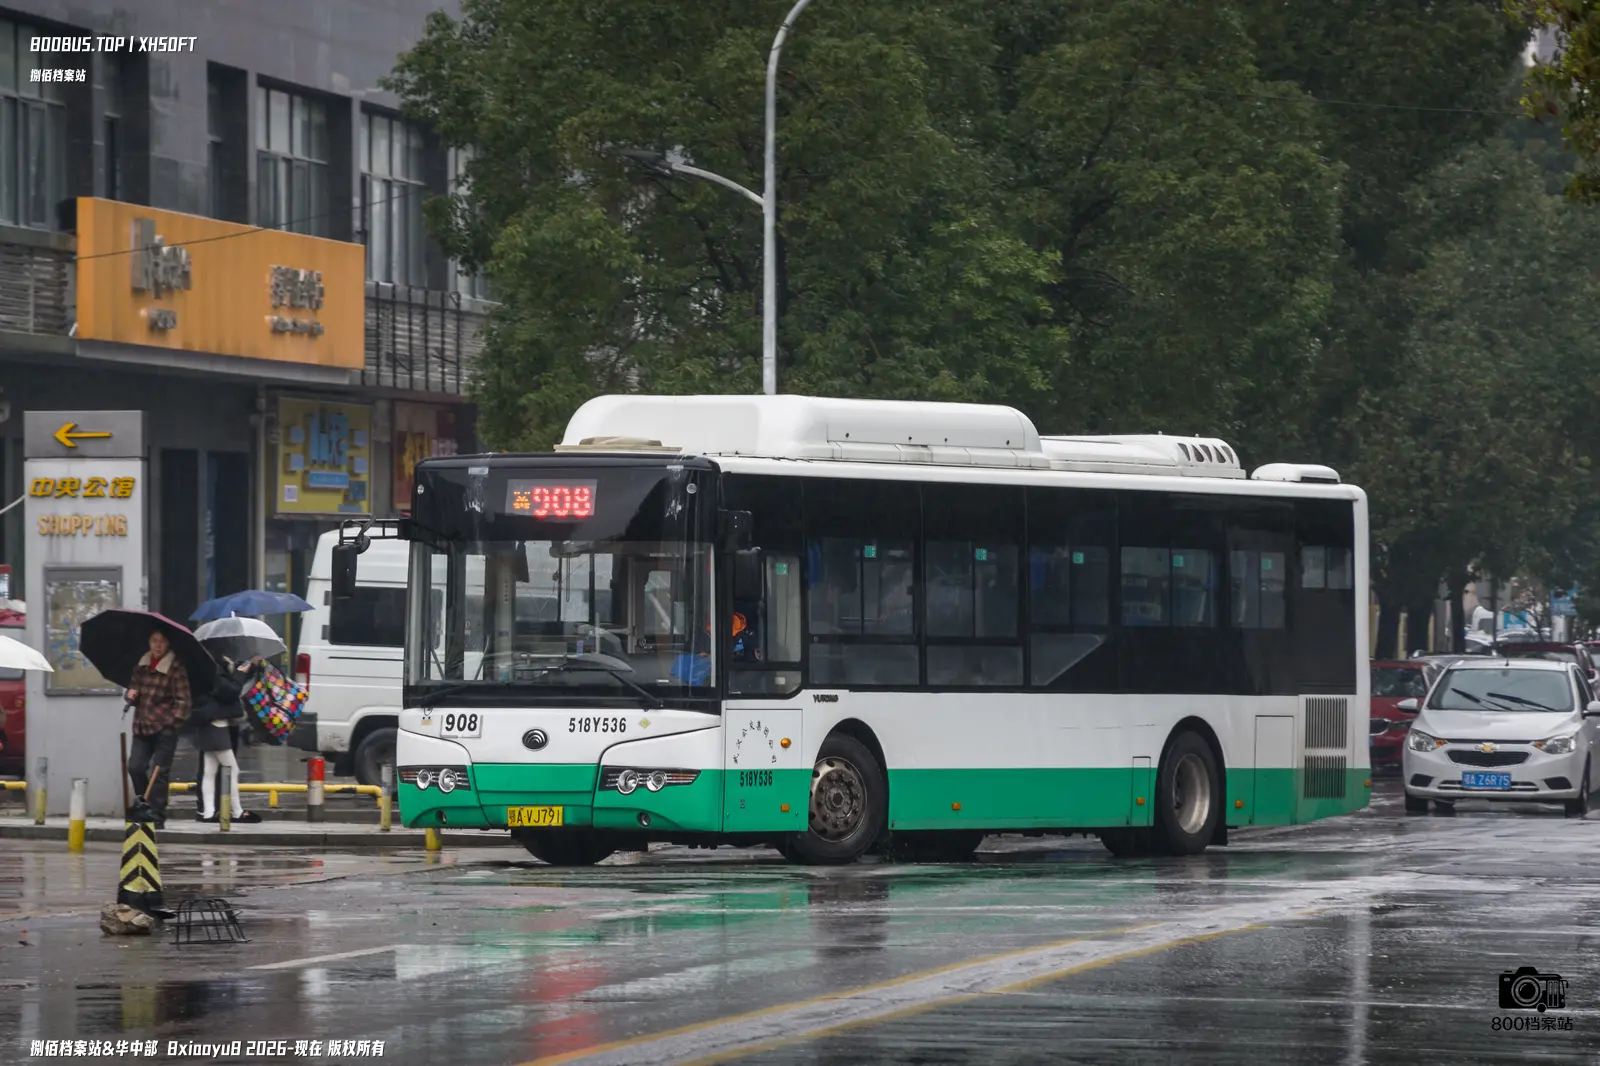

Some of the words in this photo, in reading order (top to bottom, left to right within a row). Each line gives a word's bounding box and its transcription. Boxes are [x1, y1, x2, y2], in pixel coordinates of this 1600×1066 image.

[29, 477, 135, 498] 中央公馆
[532, 487, 591, 518] 908
[37, 514, 128, 536] SHOPPING
[445, 713, 478, 732] 908
[568, 717, 627, 733] 518Y536
[739, 770, 773, 787] 518Y536
